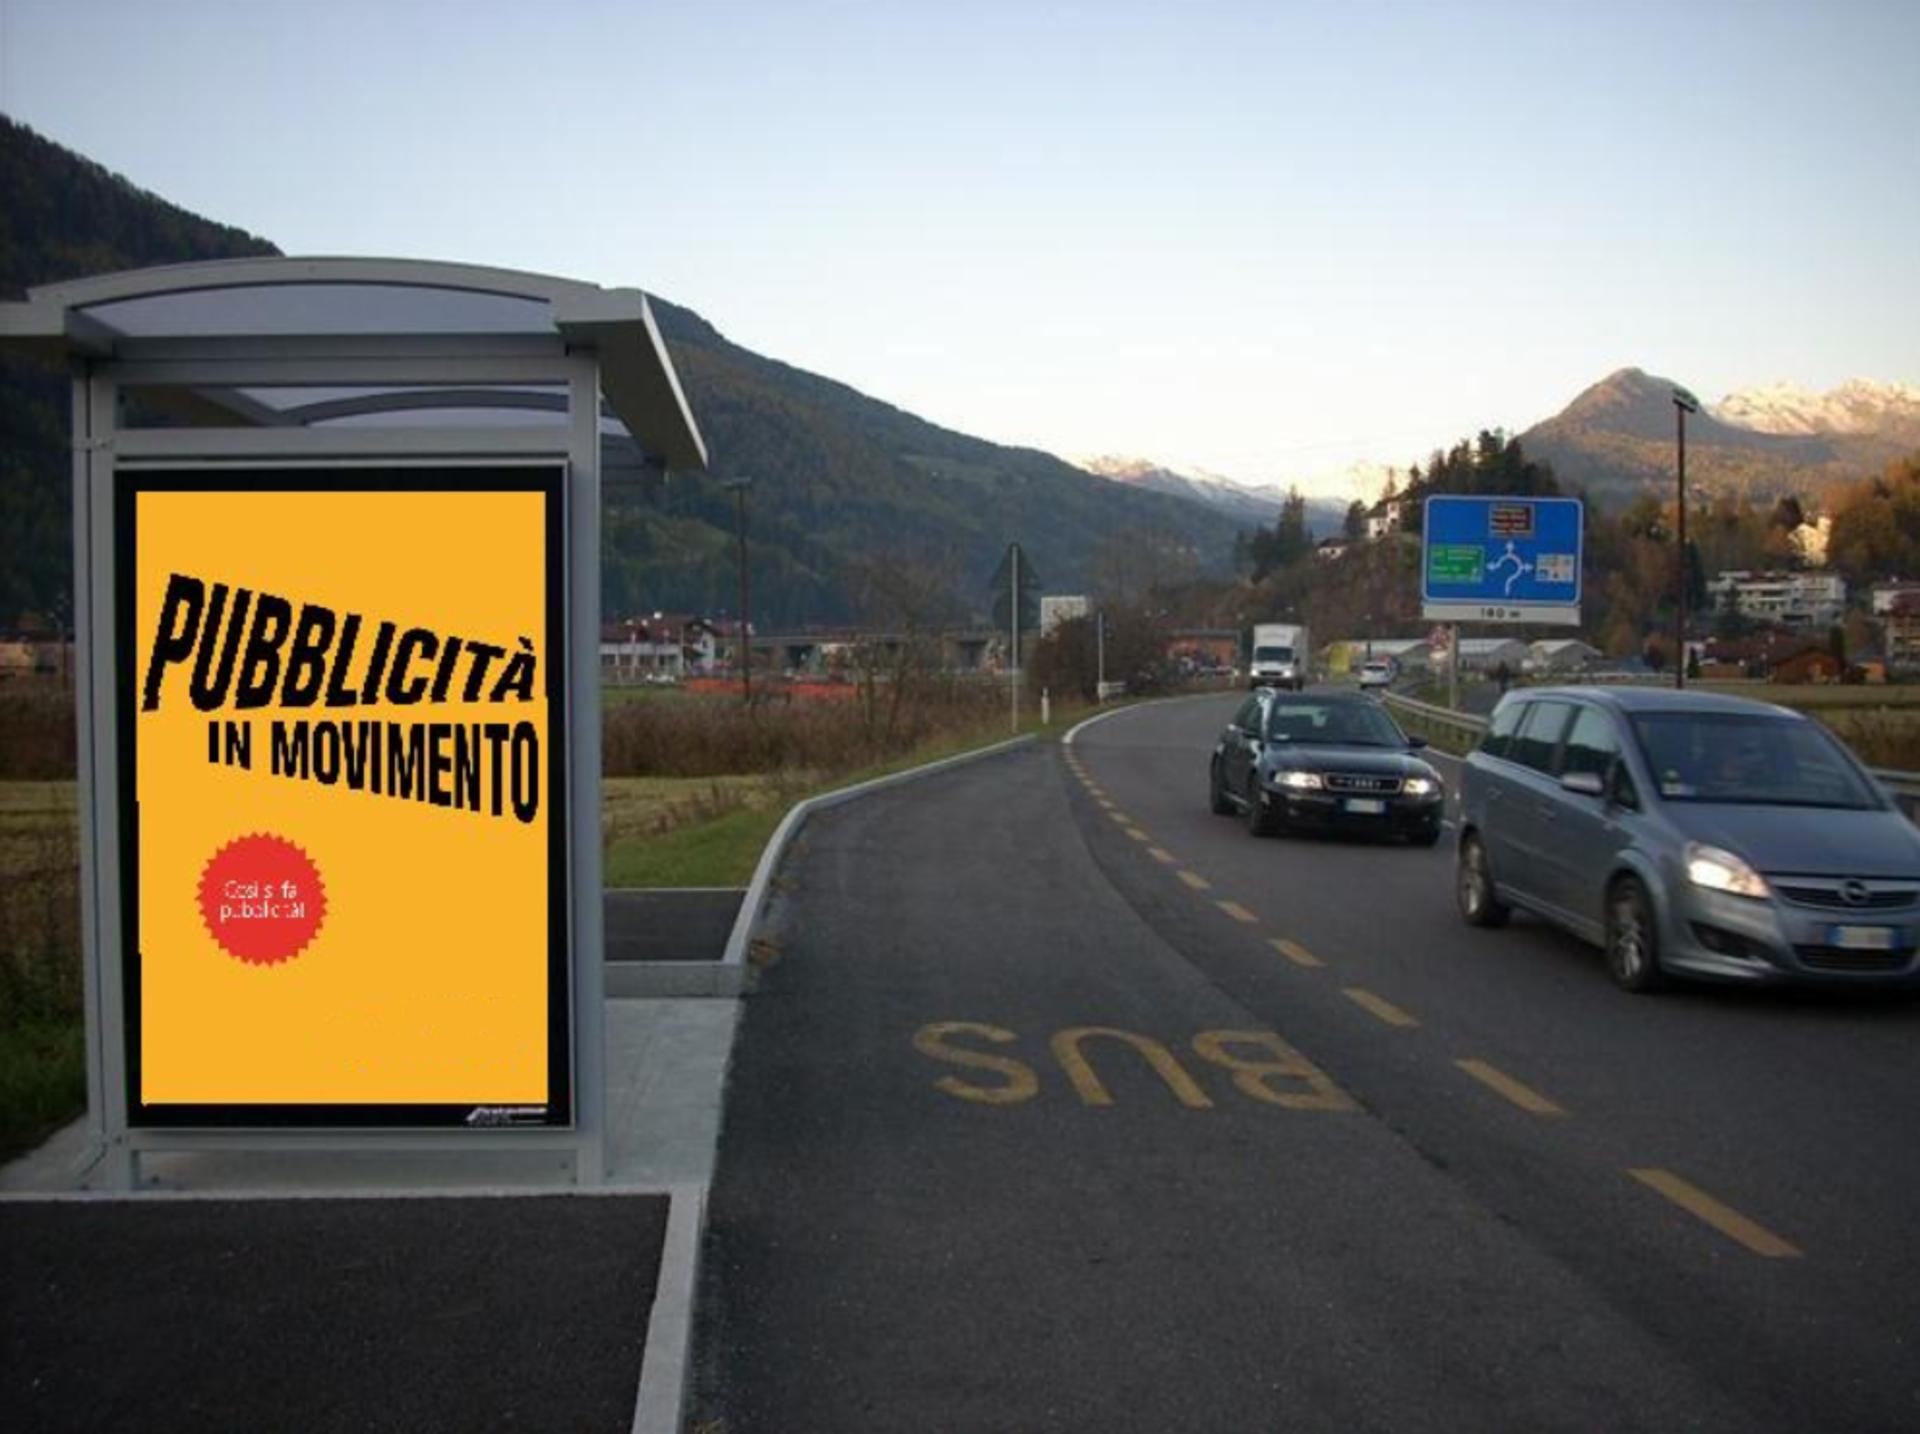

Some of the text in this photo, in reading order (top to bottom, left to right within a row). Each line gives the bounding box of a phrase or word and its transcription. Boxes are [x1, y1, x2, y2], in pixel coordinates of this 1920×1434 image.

[142, 573, 537, 713] PUBBLICITÀ
[209, 720, 539, 824] IN MOVIMENTO
[912, 1020, 1367, 1113] BUS
